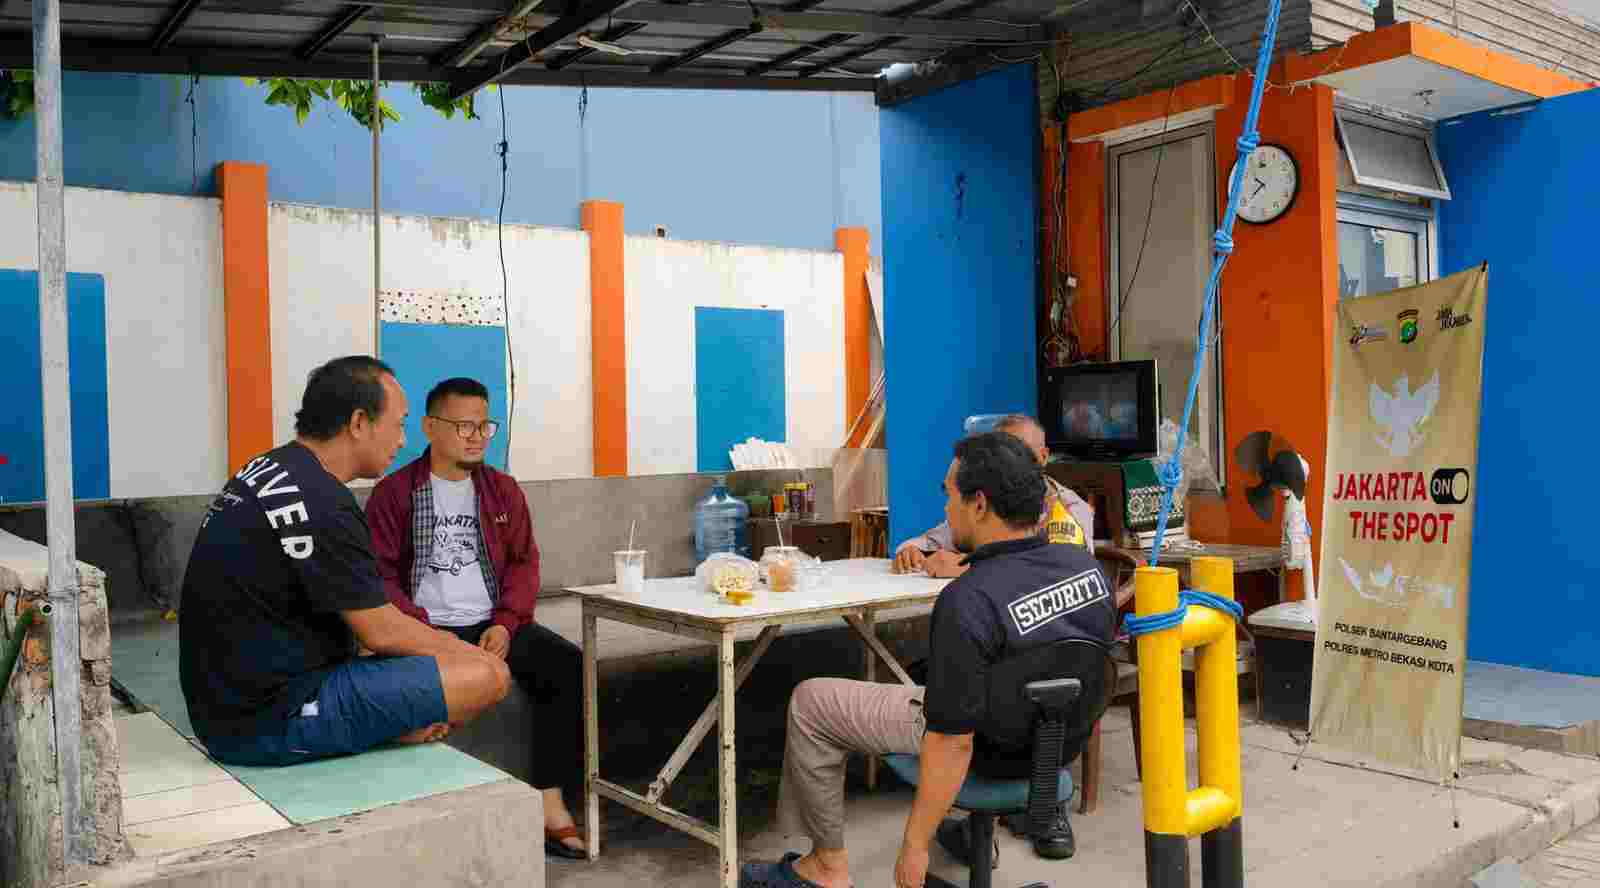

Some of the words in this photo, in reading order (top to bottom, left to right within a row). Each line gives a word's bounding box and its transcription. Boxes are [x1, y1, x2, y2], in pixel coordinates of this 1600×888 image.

[1333, 471, 1428, 501] JAKARTA
[1432, 478, 1450, 495] ON
[1350, 511, 1389, 541] THE
[1392, 512, 1455, 545] SPOT
[1335, 622, 1368, 636] POLSEK
[1369, 627, 1448, 650] BANTARGEBANG
[1324, 641, 1359, 655] POLRES
[1360, 647, 1390, 661] METRO
[1390, 652, 1426, 668] BEKASI
[1428, 659, 1455, 674] KOTA
